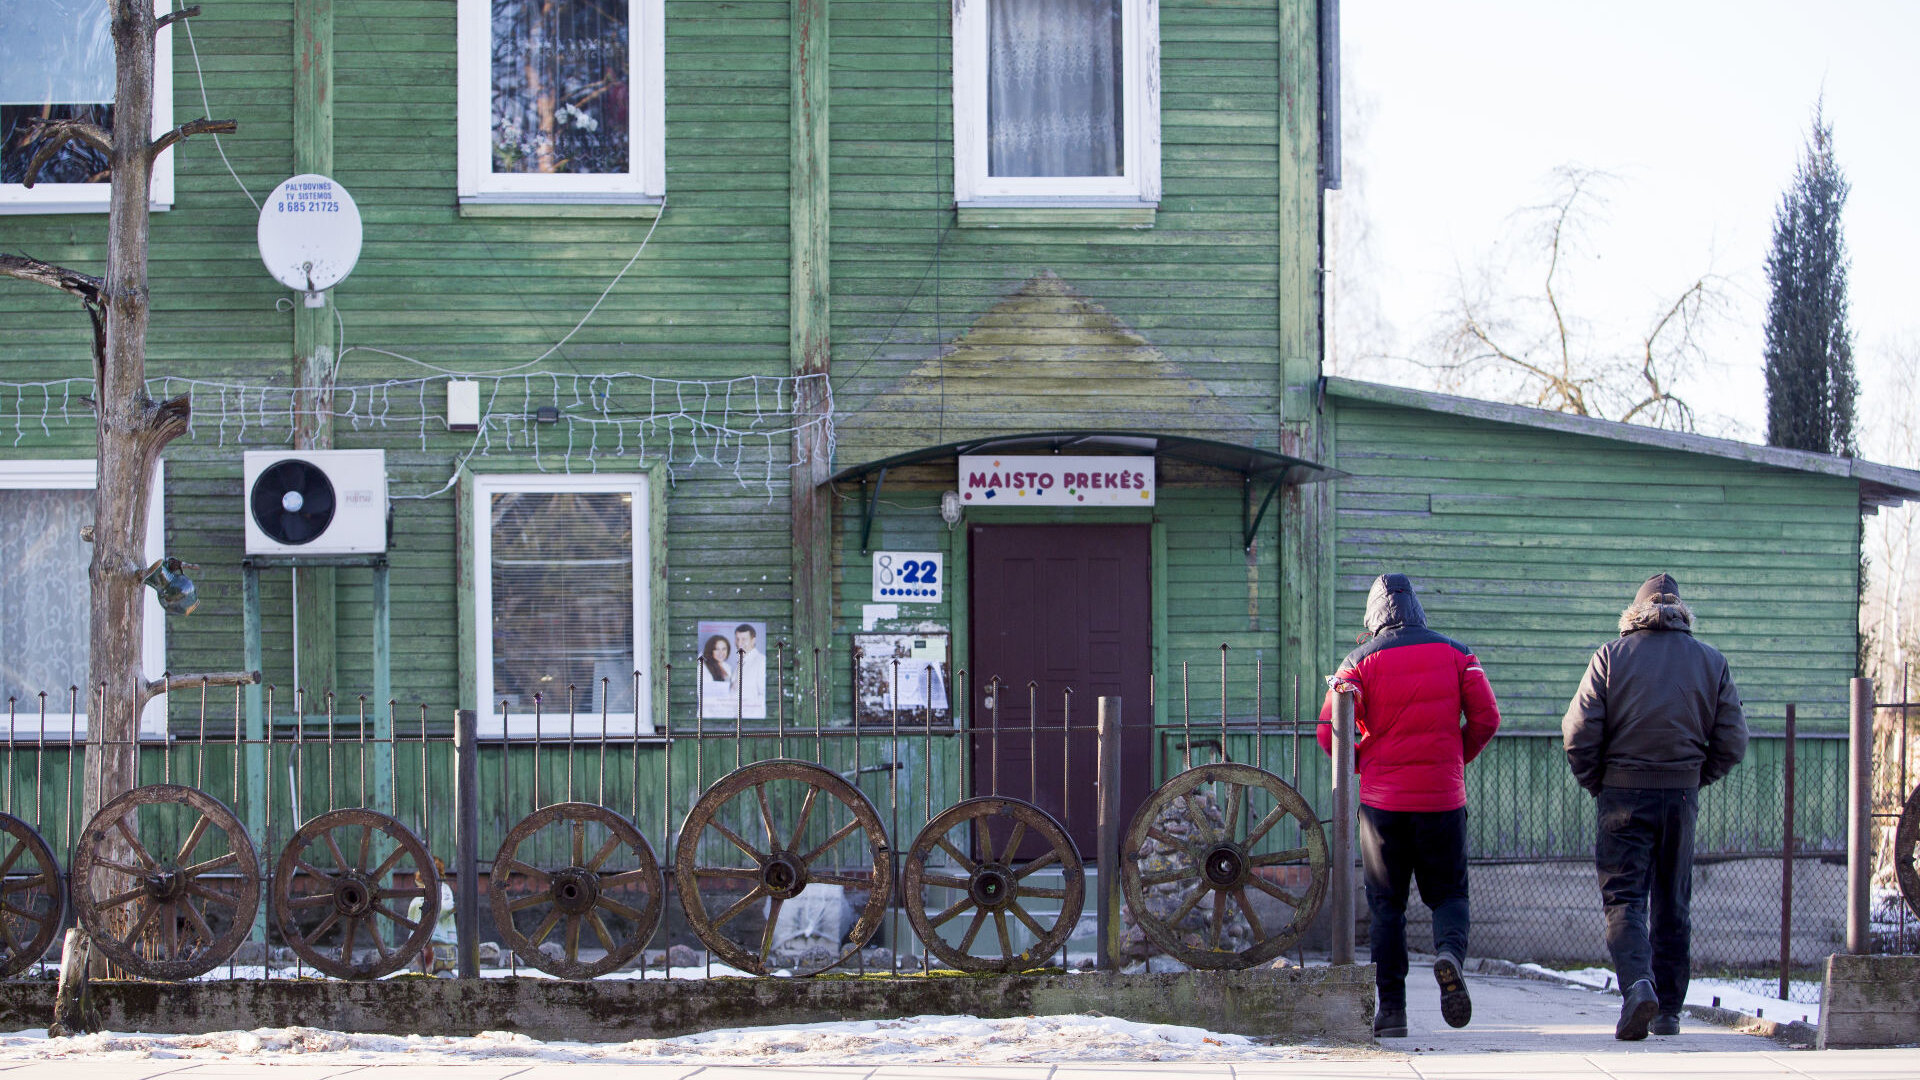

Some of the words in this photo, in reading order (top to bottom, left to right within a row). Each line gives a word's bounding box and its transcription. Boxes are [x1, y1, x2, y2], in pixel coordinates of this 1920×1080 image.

[298, 192, 332, 200] SISTEMOS
[278, 202, 284, 212] 8
[287, 202, 306, 212] 685
[308, 202, 339, 212] 21725
[968, 472, 1054, 489] MAISTO
[1064, 470, 1145, 489] PREKĖS
